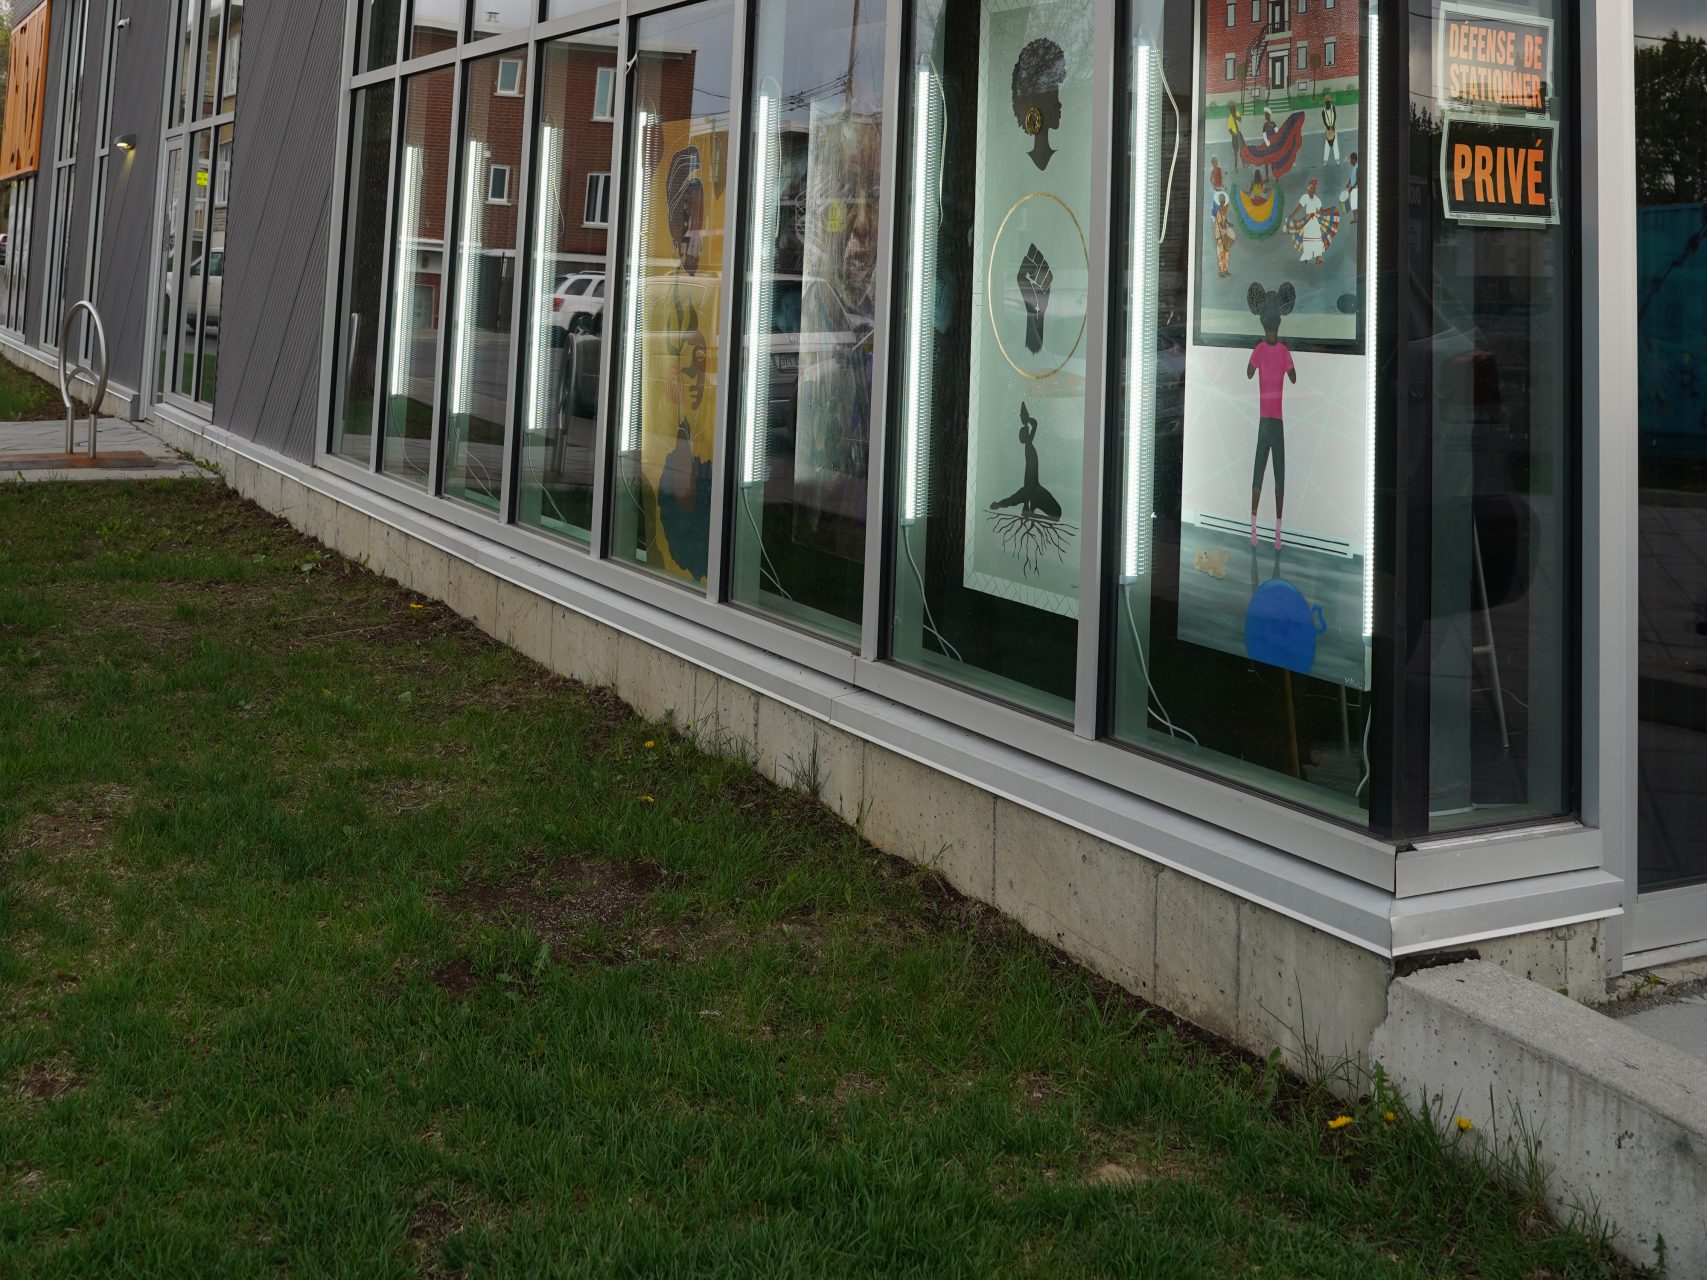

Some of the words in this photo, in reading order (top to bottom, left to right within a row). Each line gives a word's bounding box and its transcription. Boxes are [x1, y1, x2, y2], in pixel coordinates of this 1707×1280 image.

[1450, 21, 1515, 65] DÉFENSE
[1524, 35, 1544, 69] DE
[1450, 63, 1542, 108] STATIONNER
[1453, 139, 1546, 206] PRIVÉ
